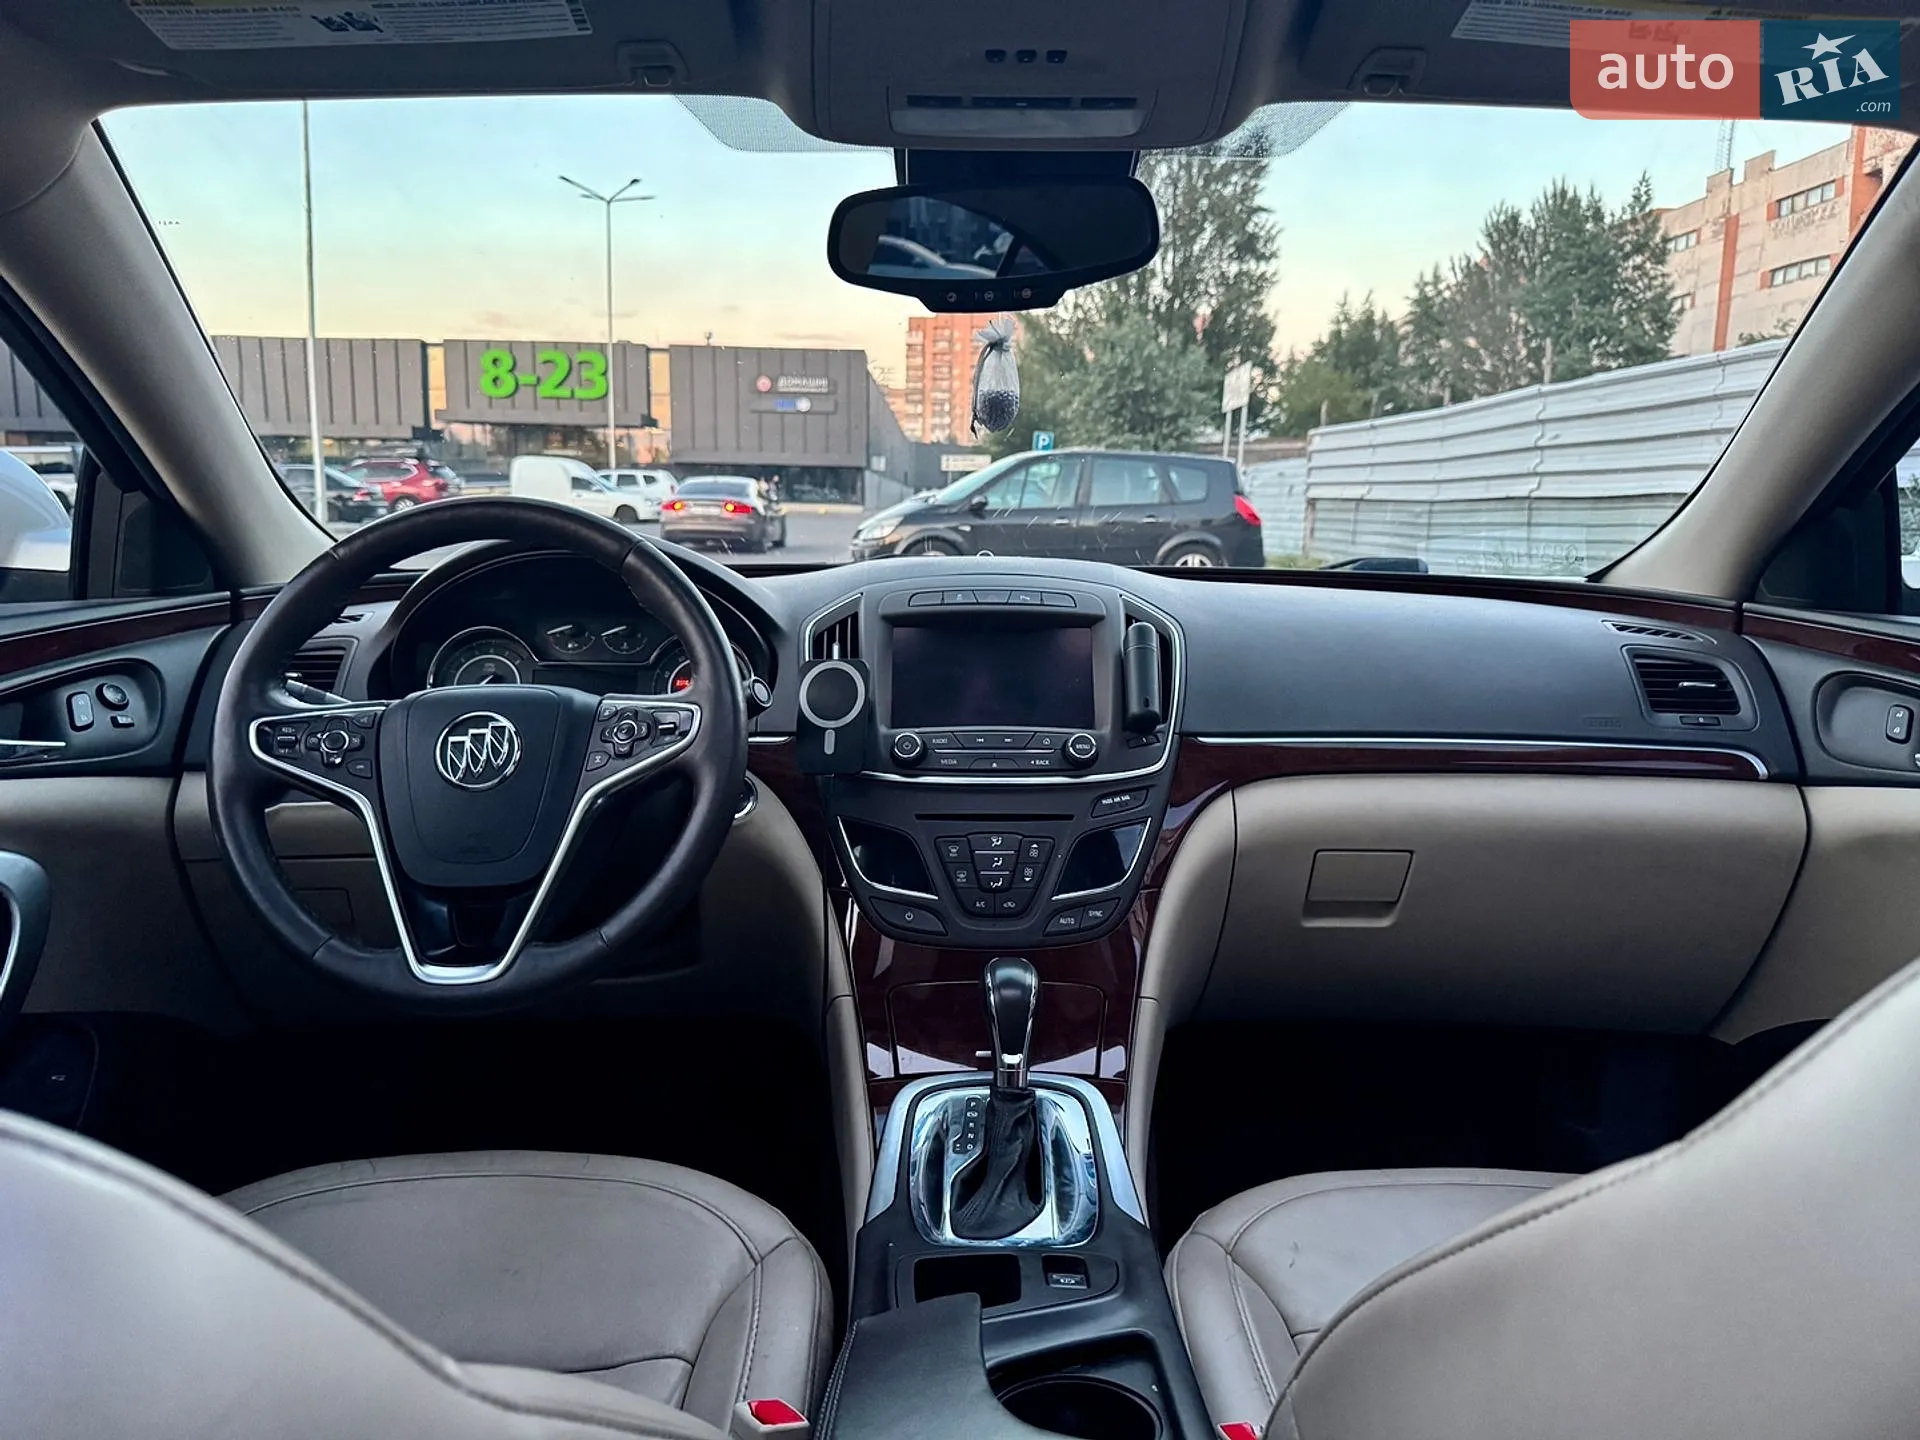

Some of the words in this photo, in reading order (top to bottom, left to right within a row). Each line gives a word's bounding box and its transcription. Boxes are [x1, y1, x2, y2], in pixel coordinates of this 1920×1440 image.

[480, 349, 608, 401] 8-23
[1037, 431, 1050, 450] P
[1035, 758, 1050, 766] BACK
[1088, 909, 1104, 918] SYNC
[1059, 917, 1075, 925] AUTO
